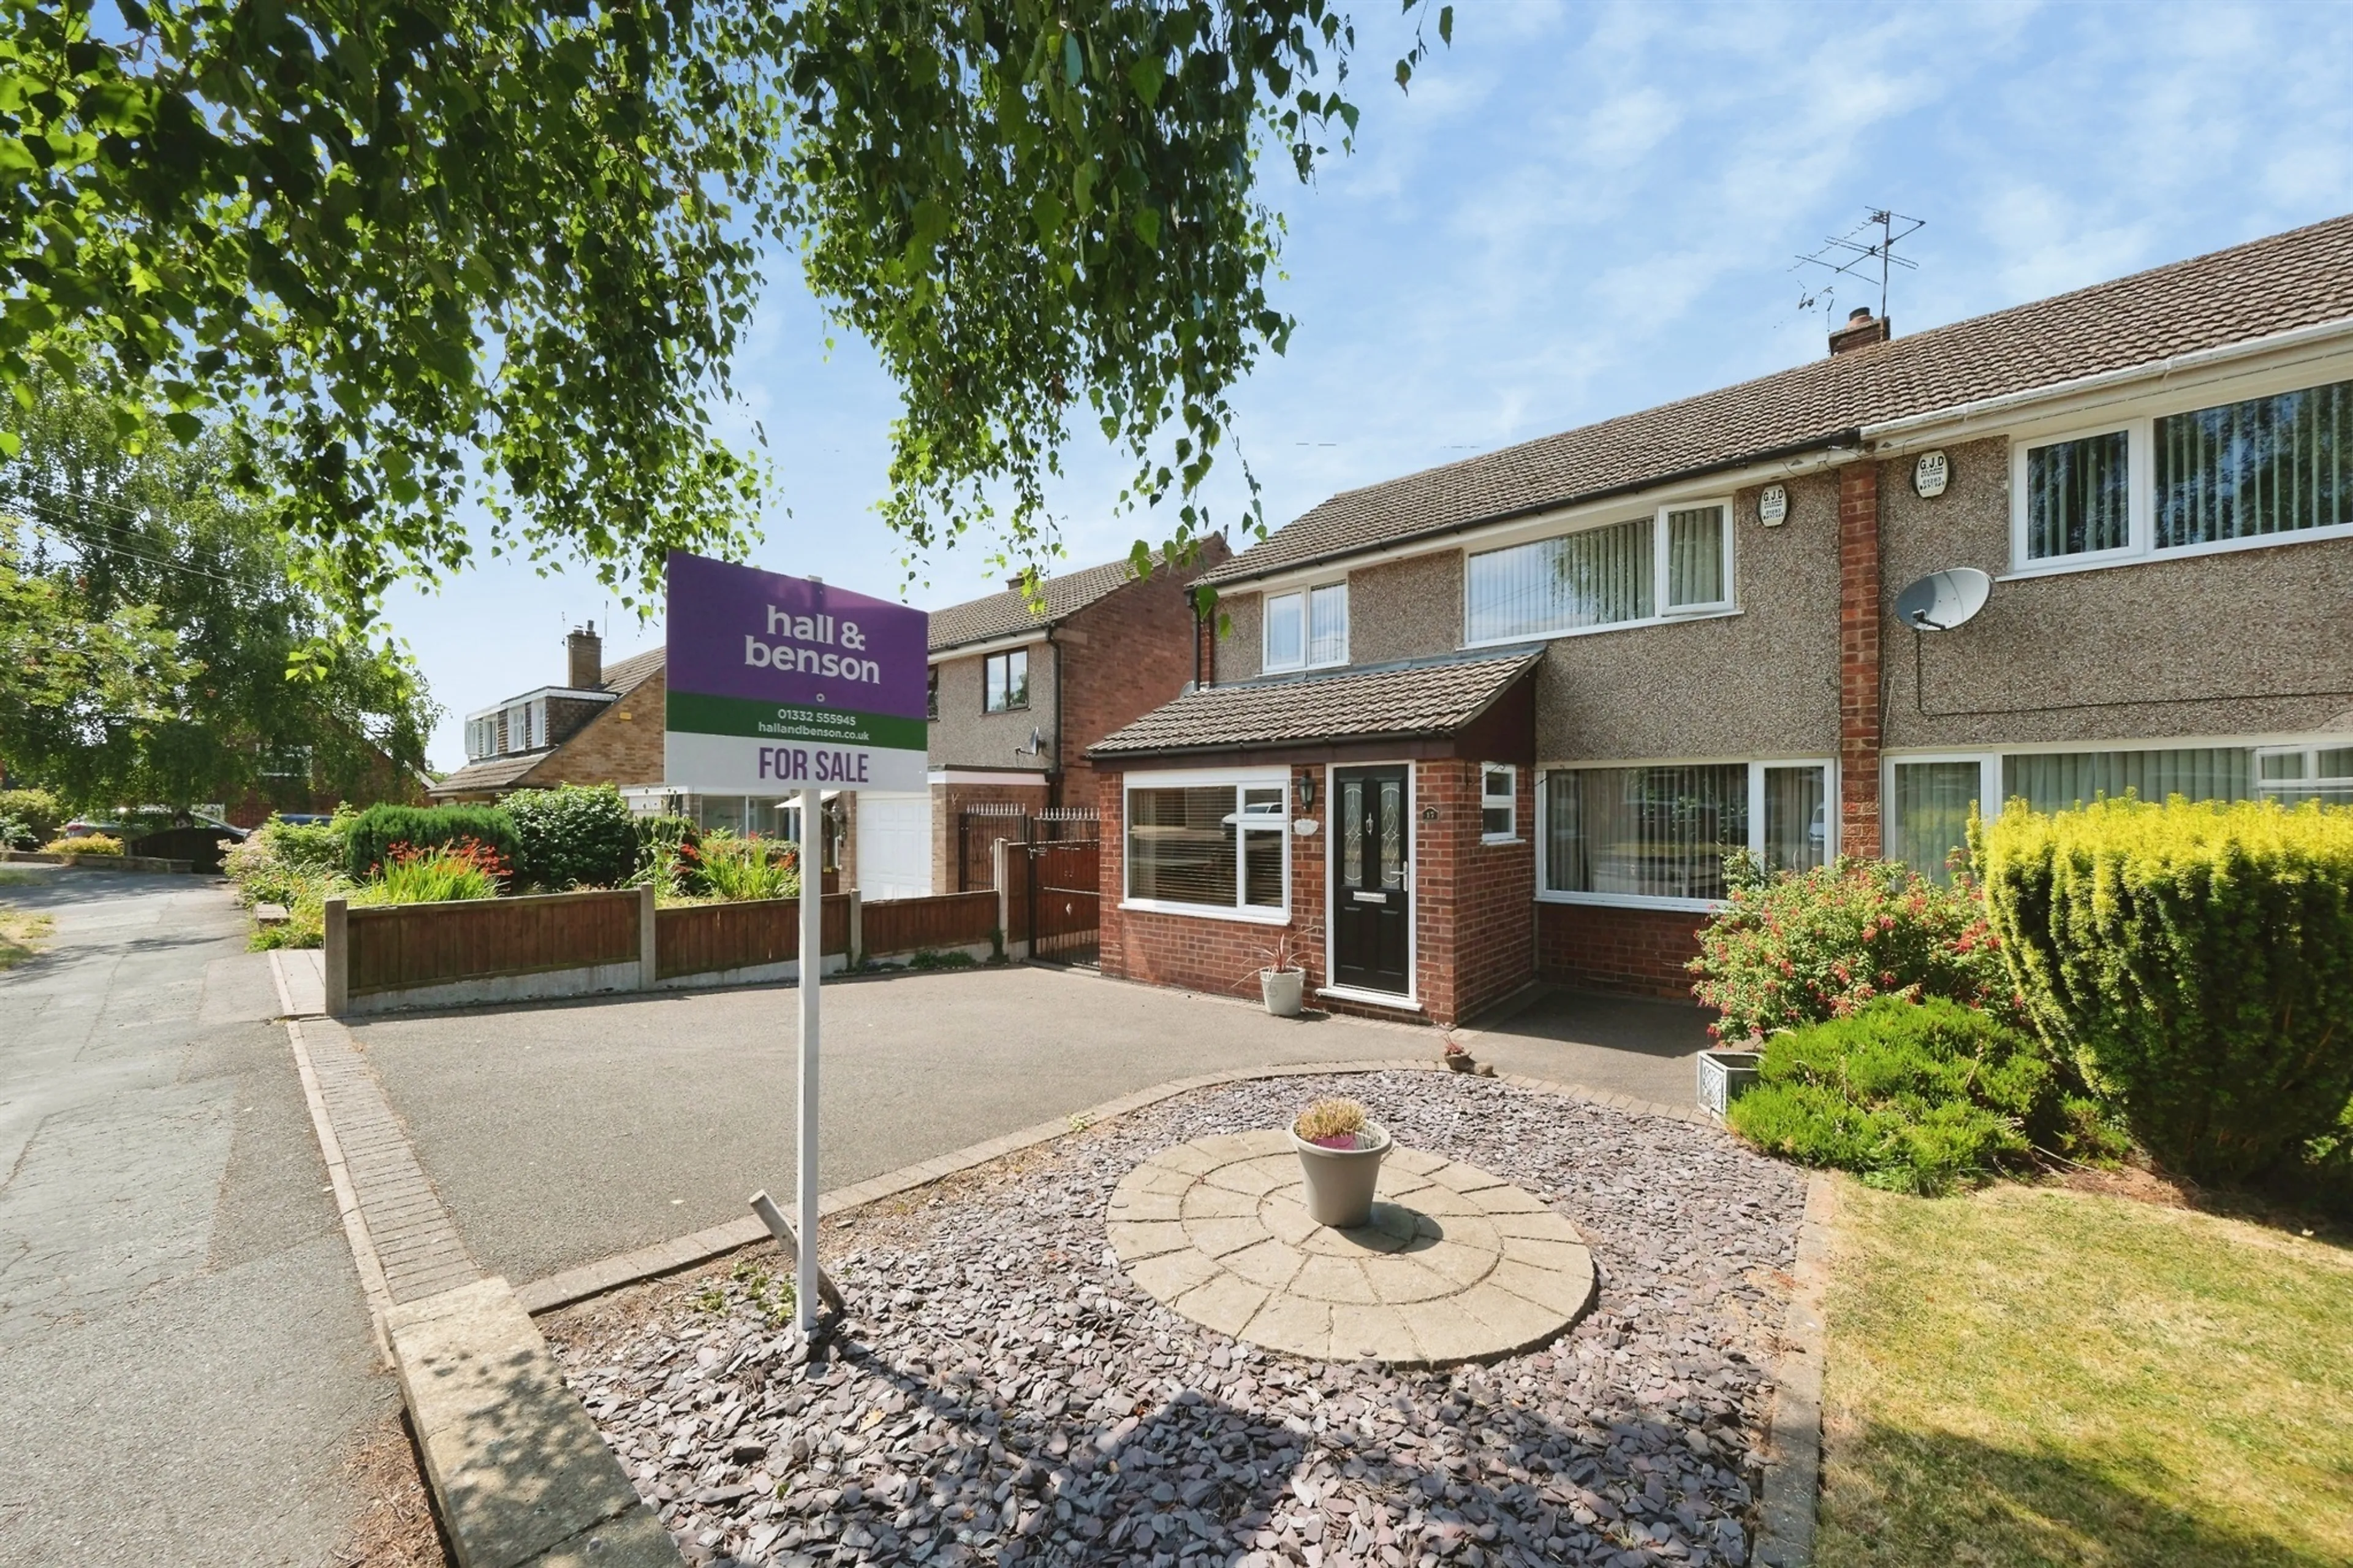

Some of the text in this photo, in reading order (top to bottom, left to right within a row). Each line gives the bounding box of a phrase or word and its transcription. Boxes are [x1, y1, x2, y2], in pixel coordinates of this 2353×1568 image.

[767, 604, 866, 651] hall &
[745, 635, 881, 684] benson
[758, 722, 870, 741] hallandbenson.co.uk
[778, 708, 856, 726] 01332 555945
[759, 747, 869, 783] FOR SALE
